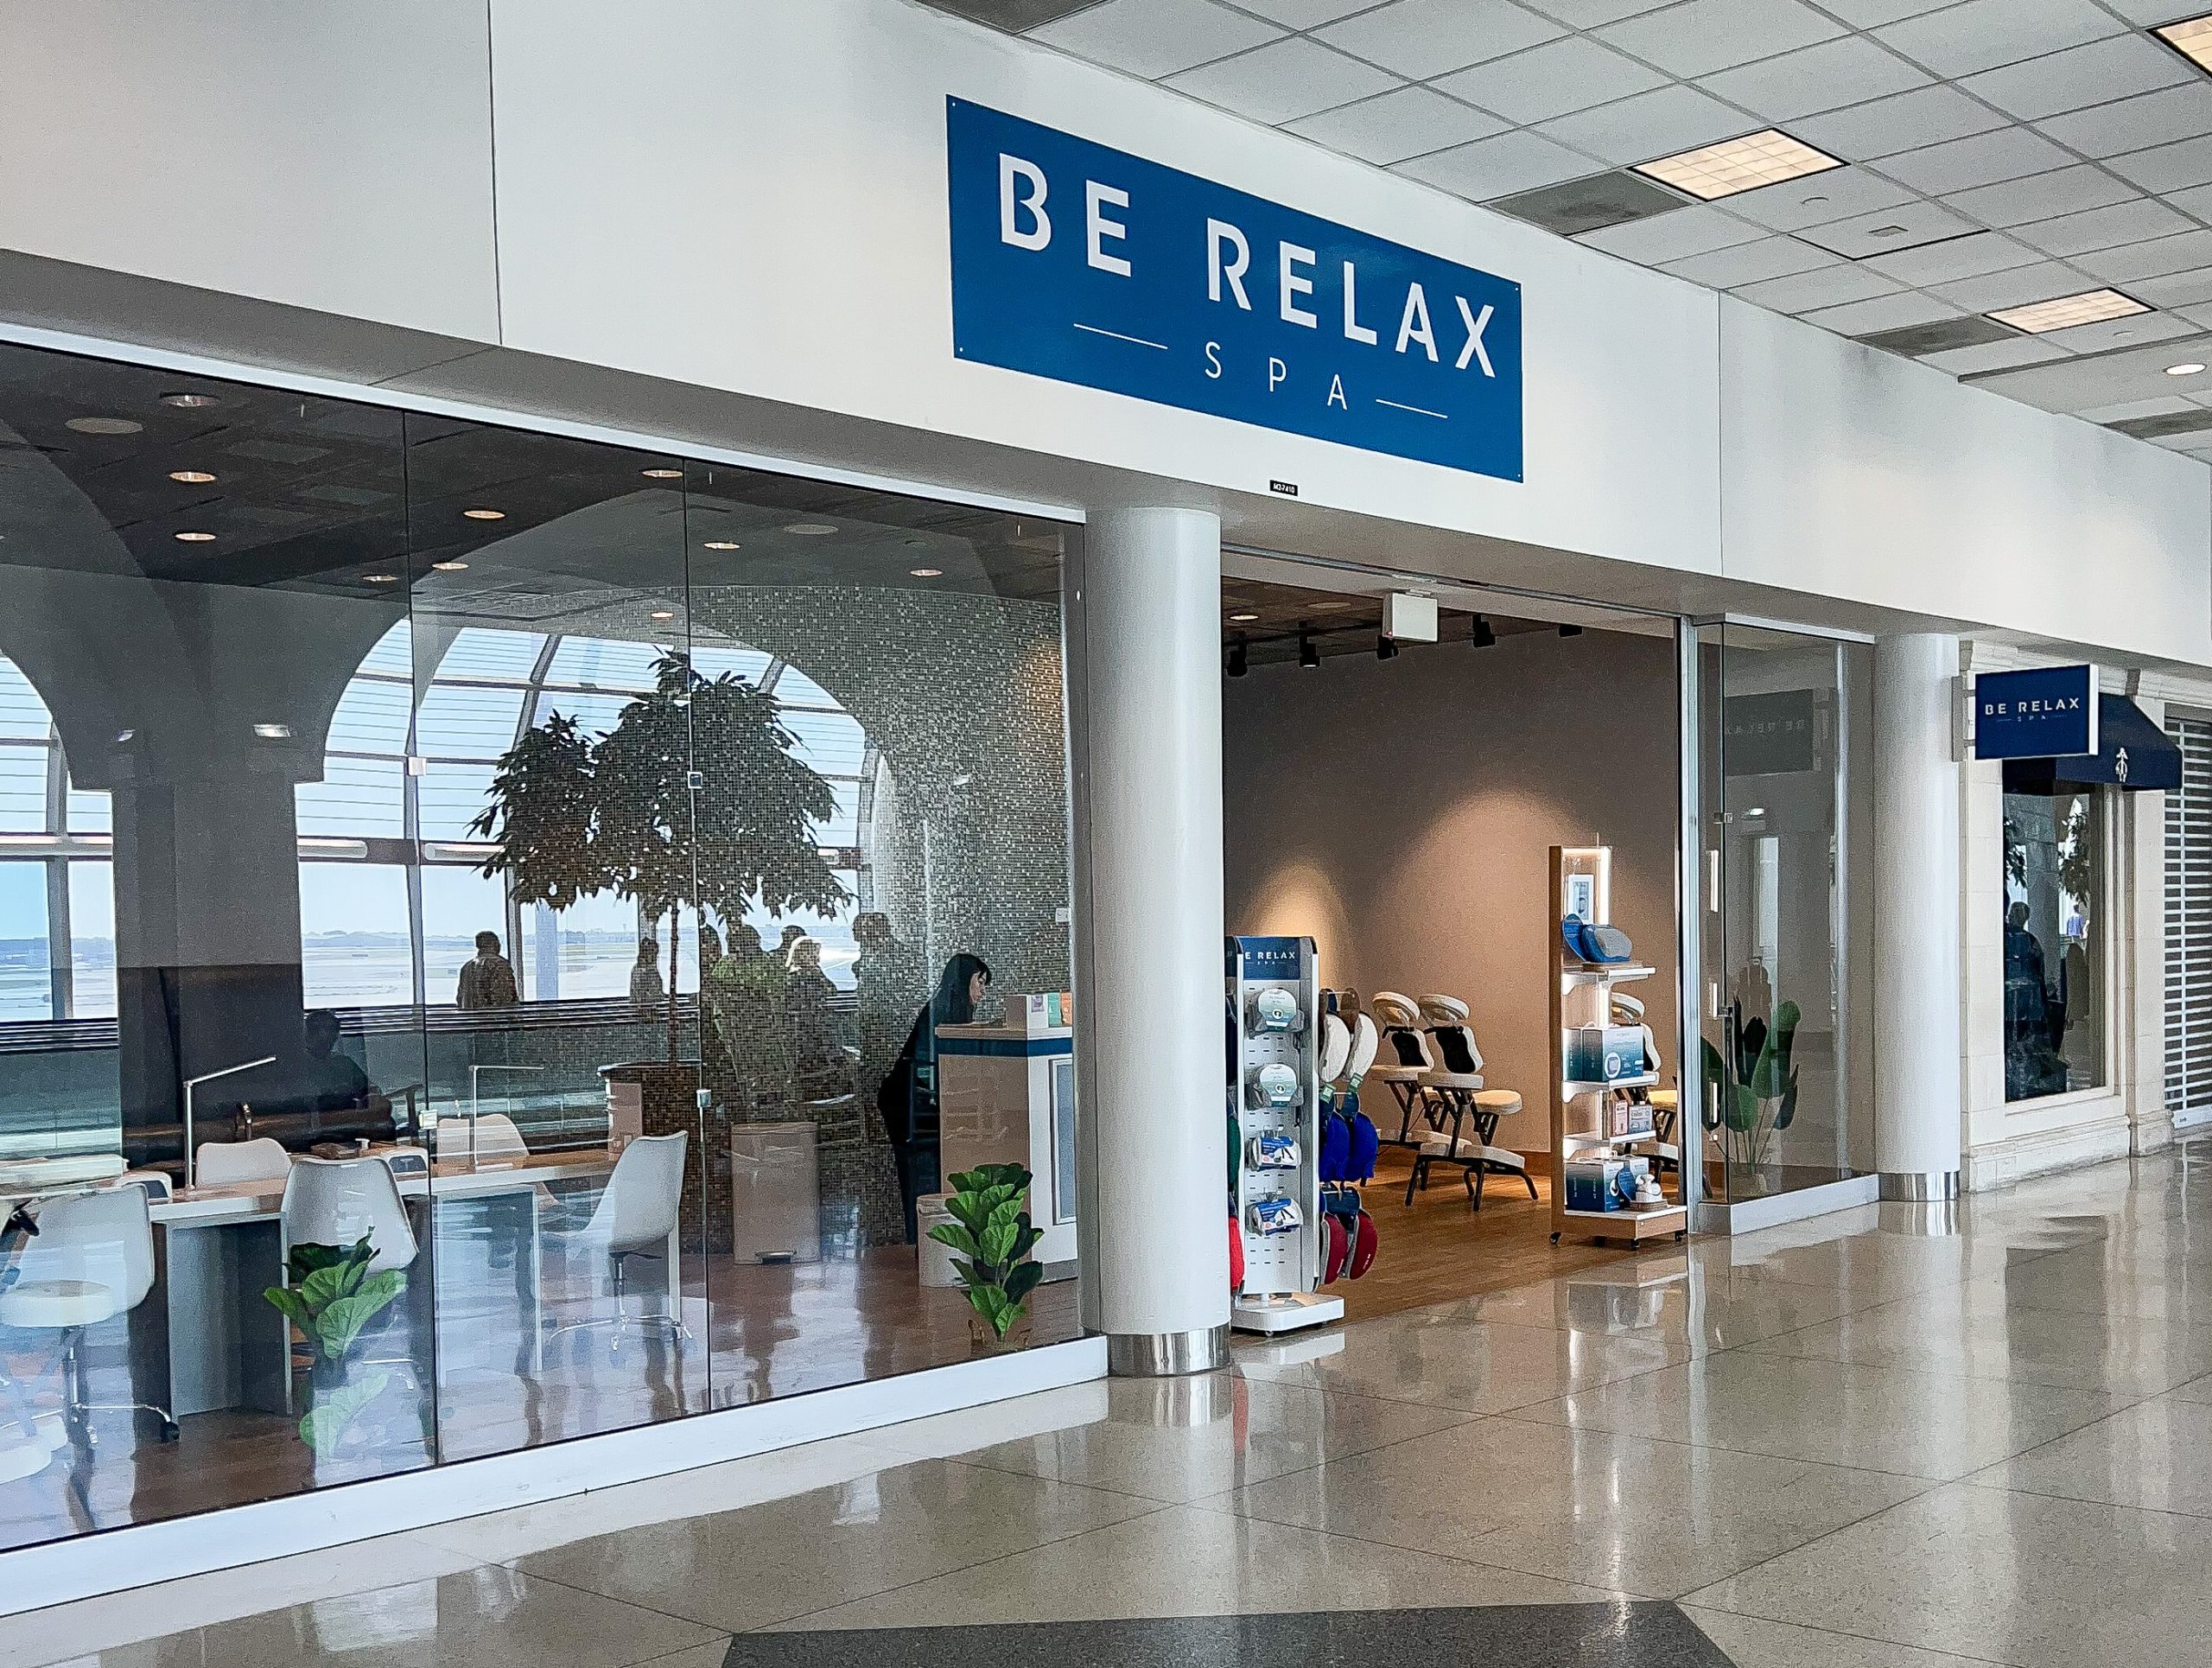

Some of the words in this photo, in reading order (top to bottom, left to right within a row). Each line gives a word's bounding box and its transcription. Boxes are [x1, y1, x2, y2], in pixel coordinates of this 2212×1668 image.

[999, 152, 1132, 277] BE
[1207, 217, 1496, 379] RELAX
[1205, 341, 1348, 411] SPA
[1985, 703, 2006, 716] BE
[2018, 697, 2079, 713] RELAX
[1257, 951, 1295, 960] RELAX
